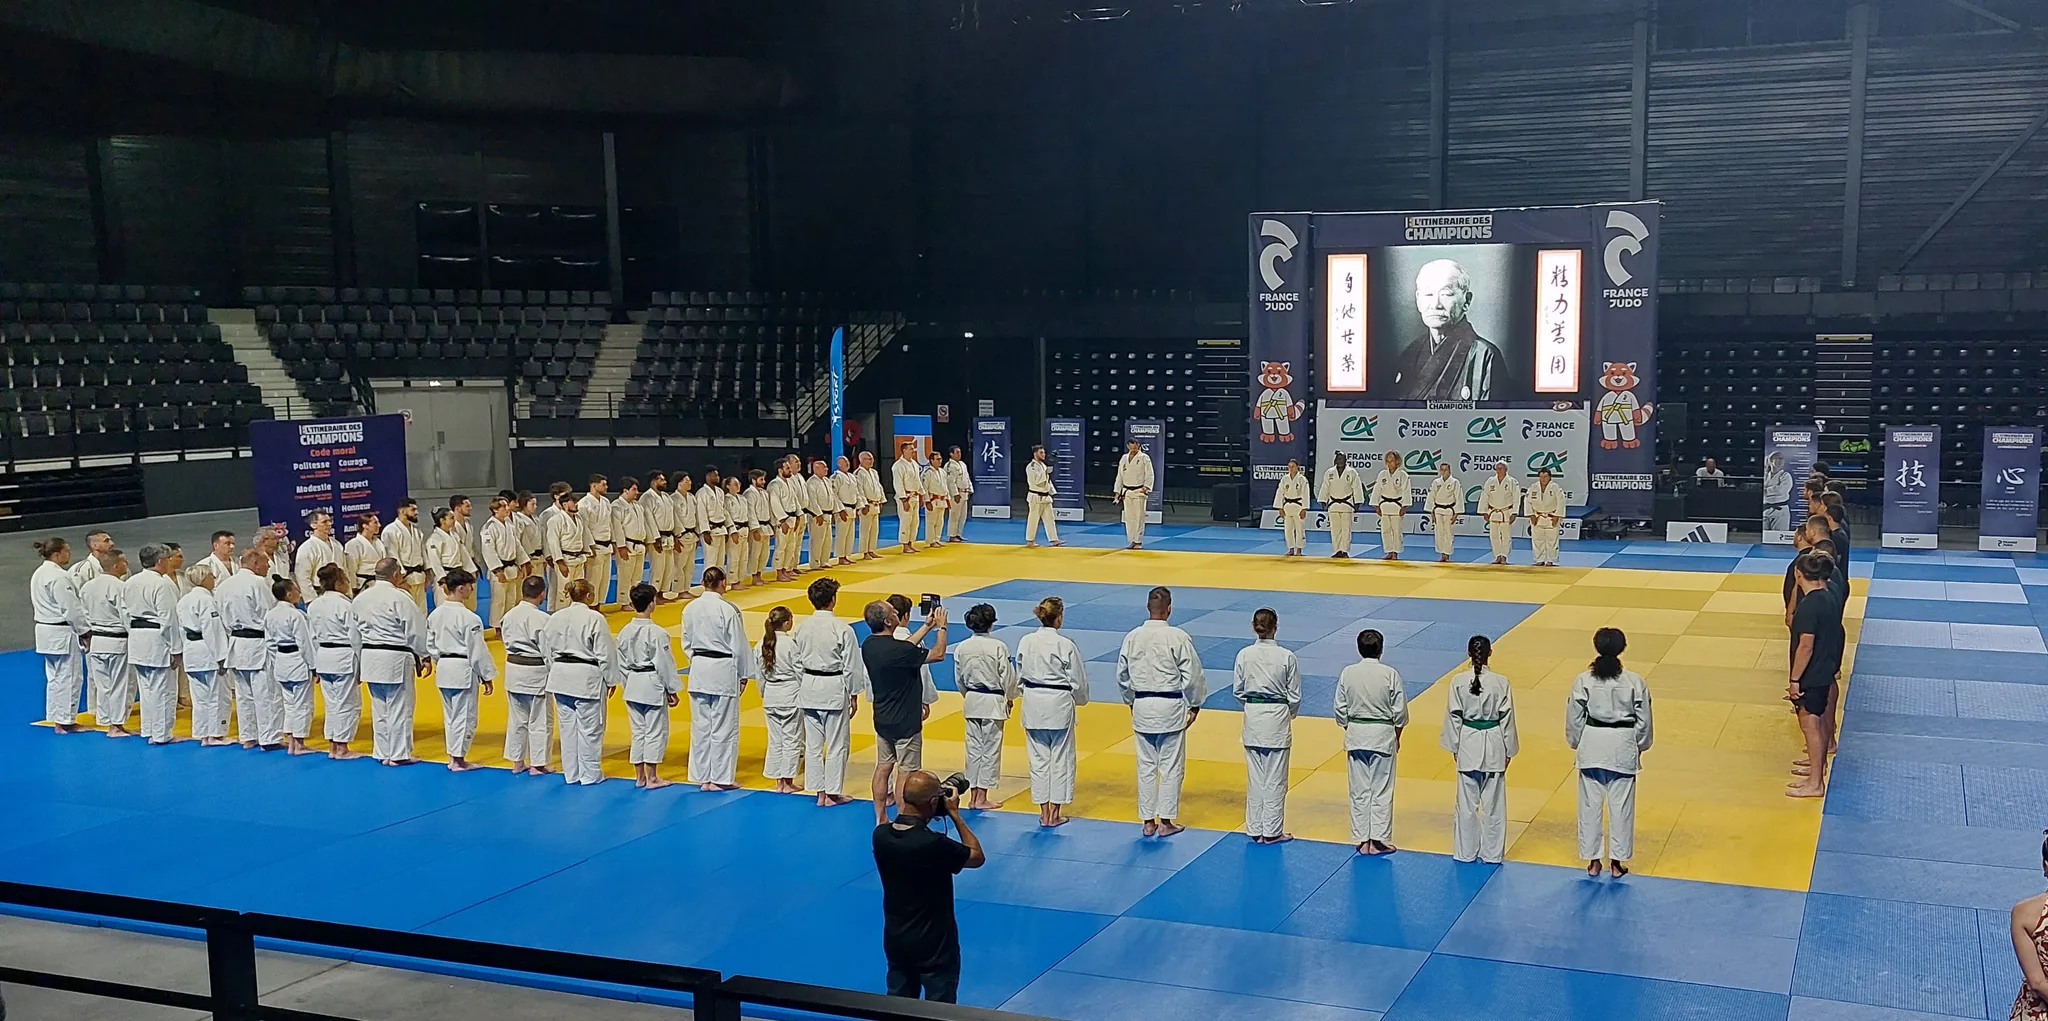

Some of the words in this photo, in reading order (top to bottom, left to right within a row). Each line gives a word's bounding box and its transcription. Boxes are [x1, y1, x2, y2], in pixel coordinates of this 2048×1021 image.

[1472, 216, 1490, 224] DES
[1405, 227, 1492, 240] CHAMPIONS
[1260, 293, 1299, 301] FRANCE
[1603, 288, 1649, 298] FRANCE
[1265, 302, 1294, 310] JUDO
[1609, 298, 1642, 308] JUDO
[1411, 429, 1437, 437] JUDO
[1536, 430, 1563, 438] JUDO
[300, 432, 364, 445] CHAMPIONS
[310, 449, 331, 457] Code
[332, 446, 356, 456] moral
[981, 440, 1004, 465] 体
[1347, 453, 1383, 461] FRANCE
[293, 462, 330, 471] Politesse
[339, 459, 368, 467] Courage
[1895, 460, 1927, 487] 技
[1996, 468, 2026, 485] 心
[296, 484, 332, 493] Modestie
[340, 480, 369, 489] Respect
[1592, 481, 1653, 490] CHAMPIONS
[341, 504, 371, 512] Honneur
